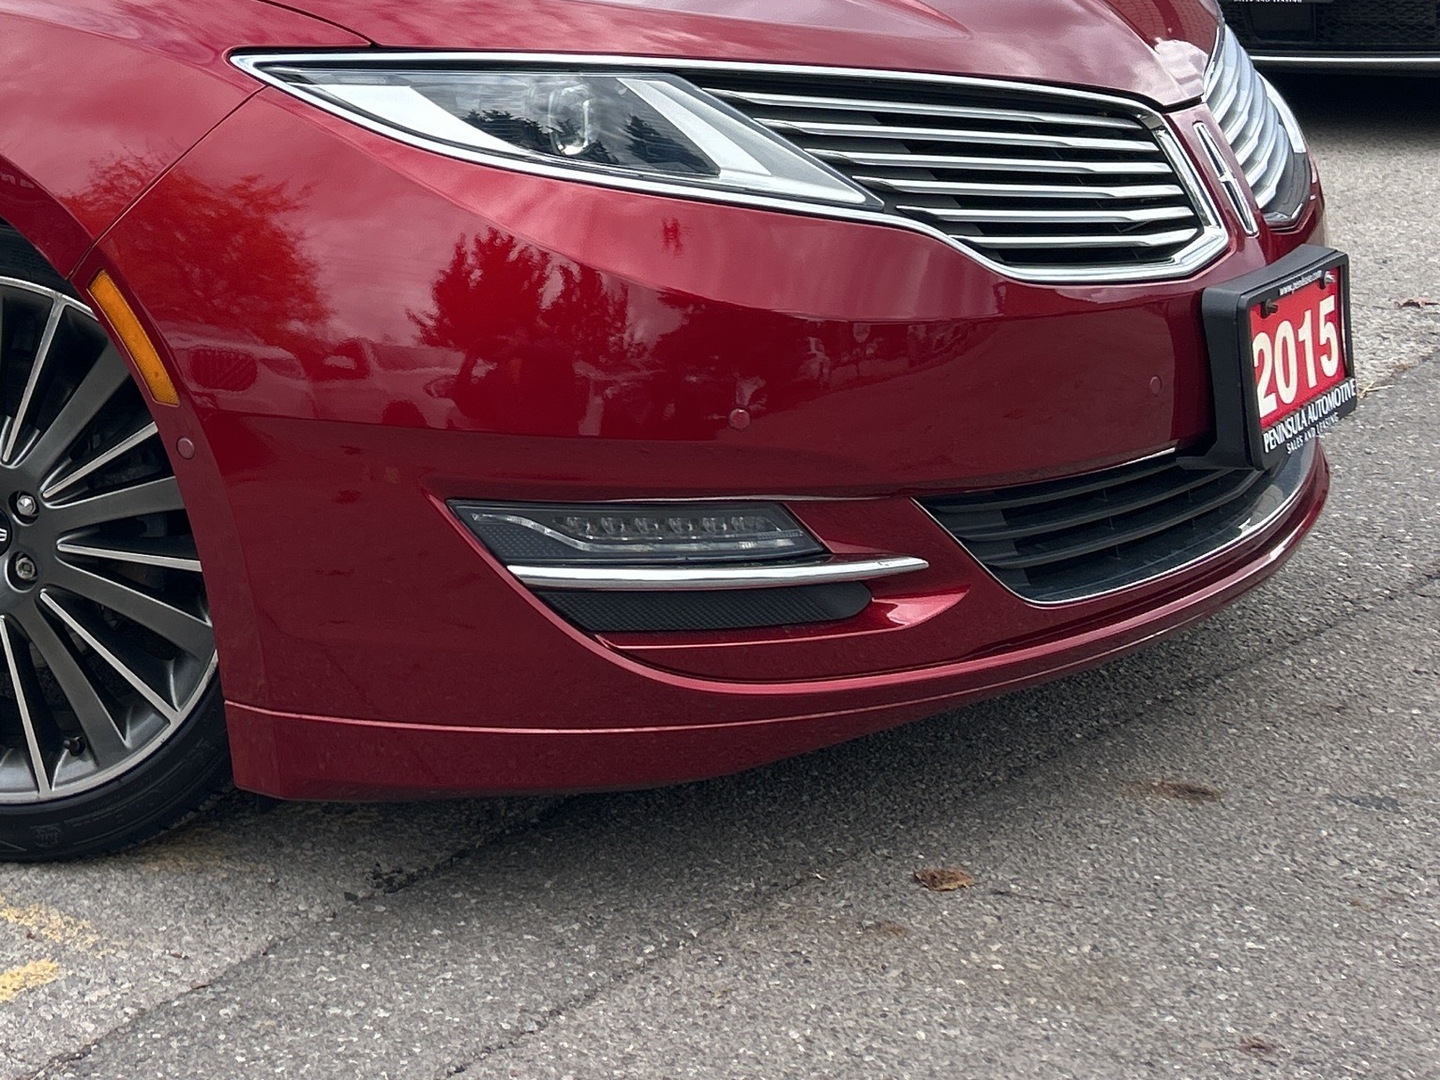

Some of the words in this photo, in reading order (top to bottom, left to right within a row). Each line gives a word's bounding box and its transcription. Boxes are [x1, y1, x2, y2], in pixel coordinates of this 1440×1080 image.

[1252, 295, 1339, 418] 2015
[1263, 407, 1307, 453] PENINSULA
[1307, 378, 1356, 424] AUTOMOTIVE
[1287, 435, 1303, 454] SALES
[1304, 427, 1316, 441] AND
